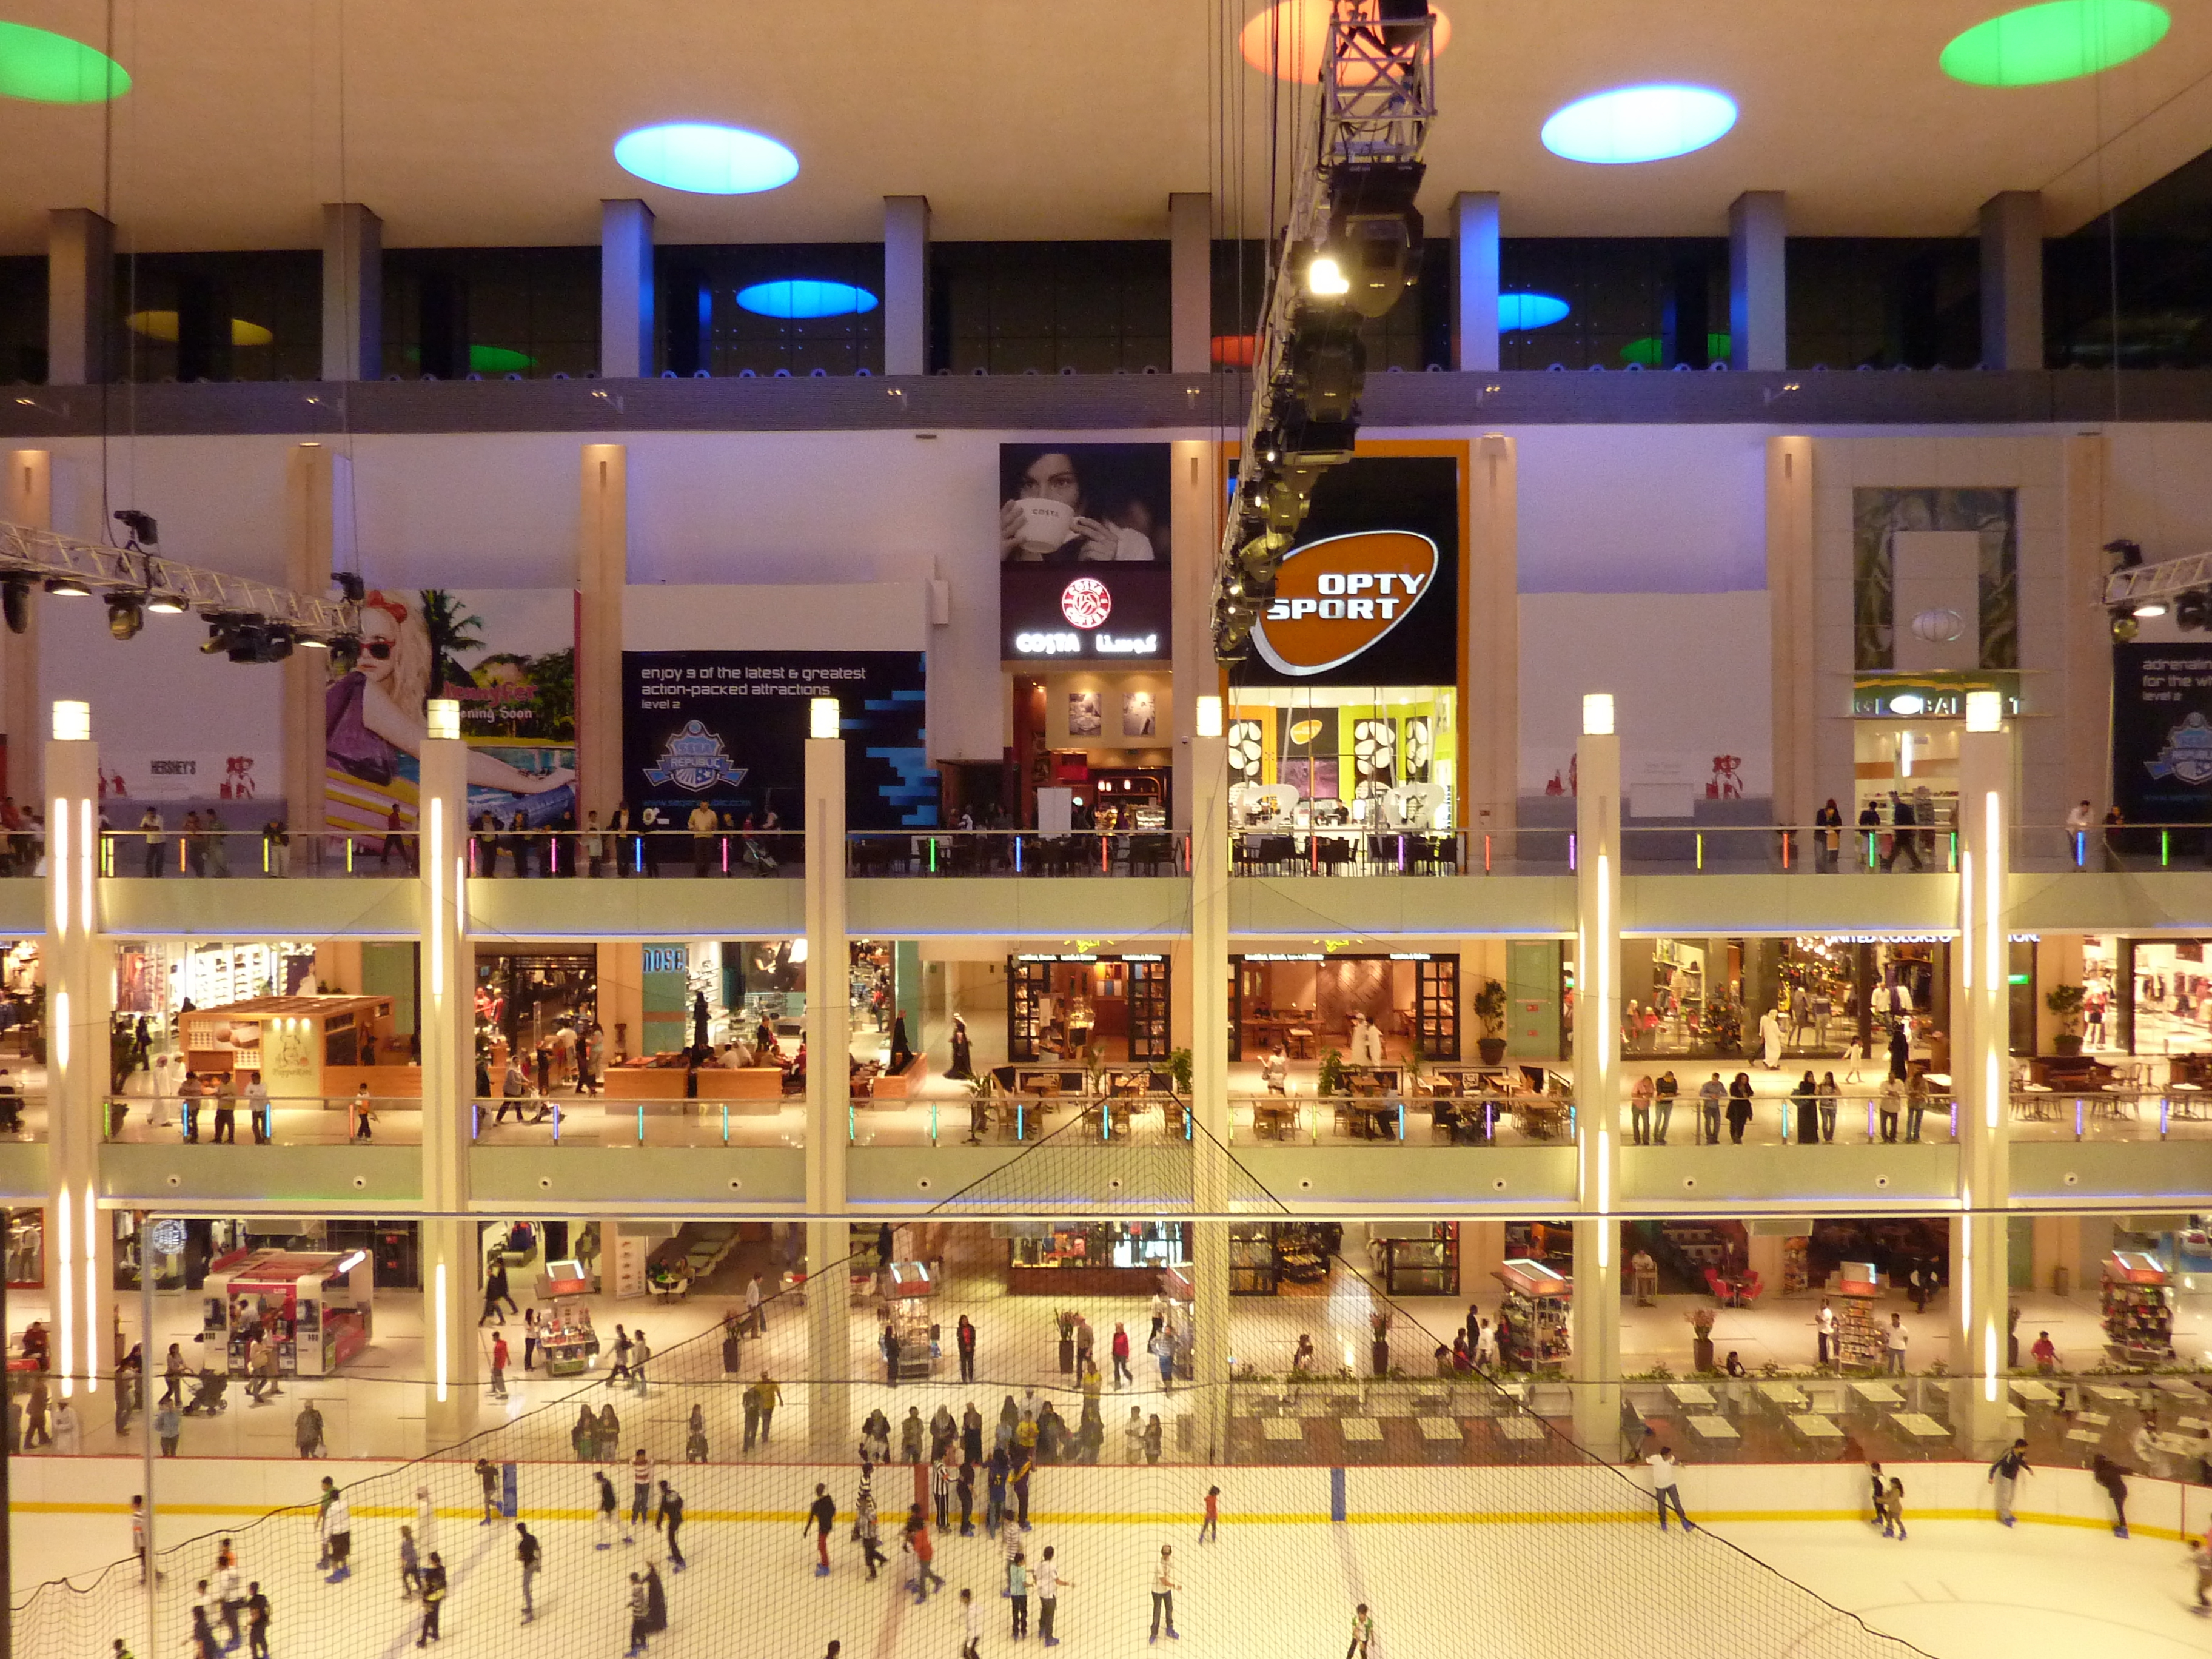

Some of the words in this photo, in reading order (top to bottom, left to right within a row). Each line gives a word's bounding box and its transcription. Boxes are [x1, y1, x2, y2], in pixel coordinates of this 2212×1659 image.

[1068, 580, 1104, 596] COSTA
[1318, 573, 1425, 595] OPTY
[1267, 598, 1399, 620] SPORT
[1016, 634, 1080, 654] COSTA
[642, 668, 682, 681] enjoy
[686, 669, 695, 679] 9
[700, 667, 714, 679] of
[717, 667, 741, 679] the
[745, 667, 785, 679] latest
[789, 669, 799, 679] &
[802, 668, 866, 681] greatest
[2143, 675, 2165, 686] for
[2169, 675, 2191, 686] the
[642, 683, 748, 697] action-packed
[751, 685, 831, 695] attractions
[642, 700, 669, 709] level
[459, 708, 495, 723] ening
[499, 706, 532, 719] Soon
[671, 757, 721, 768] REPUBLIC
